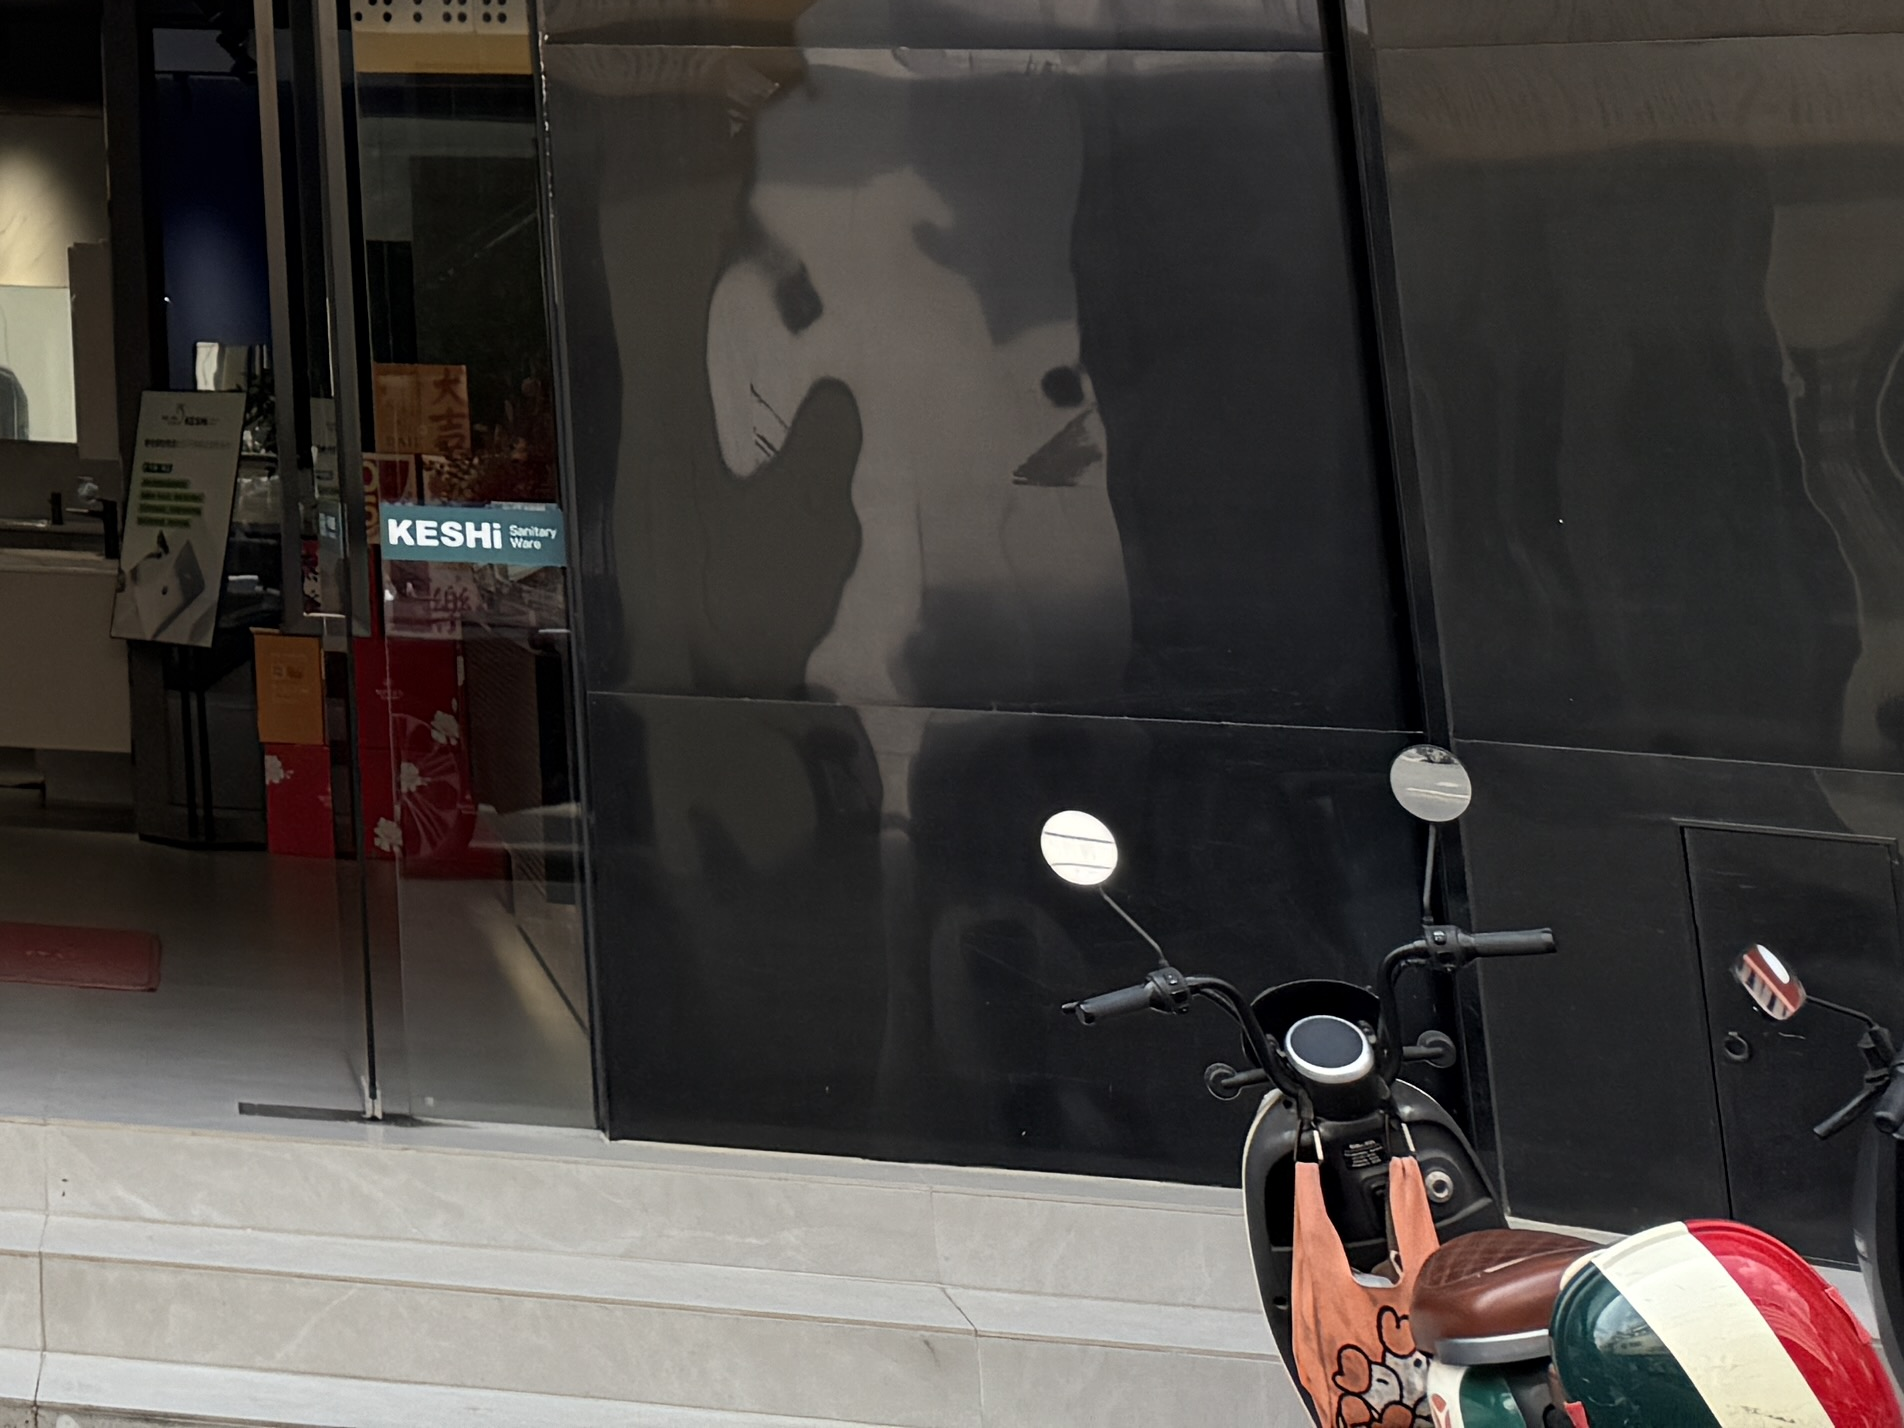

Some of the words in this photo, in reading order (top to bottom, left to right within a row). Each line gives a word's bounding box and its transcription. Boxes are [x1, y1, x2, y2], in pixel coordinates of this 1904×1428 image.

[387, 518, 503, 549] KESHi
[509, 524, 557, 540] Sanitary
[509, 537, 542, 550] Ware
